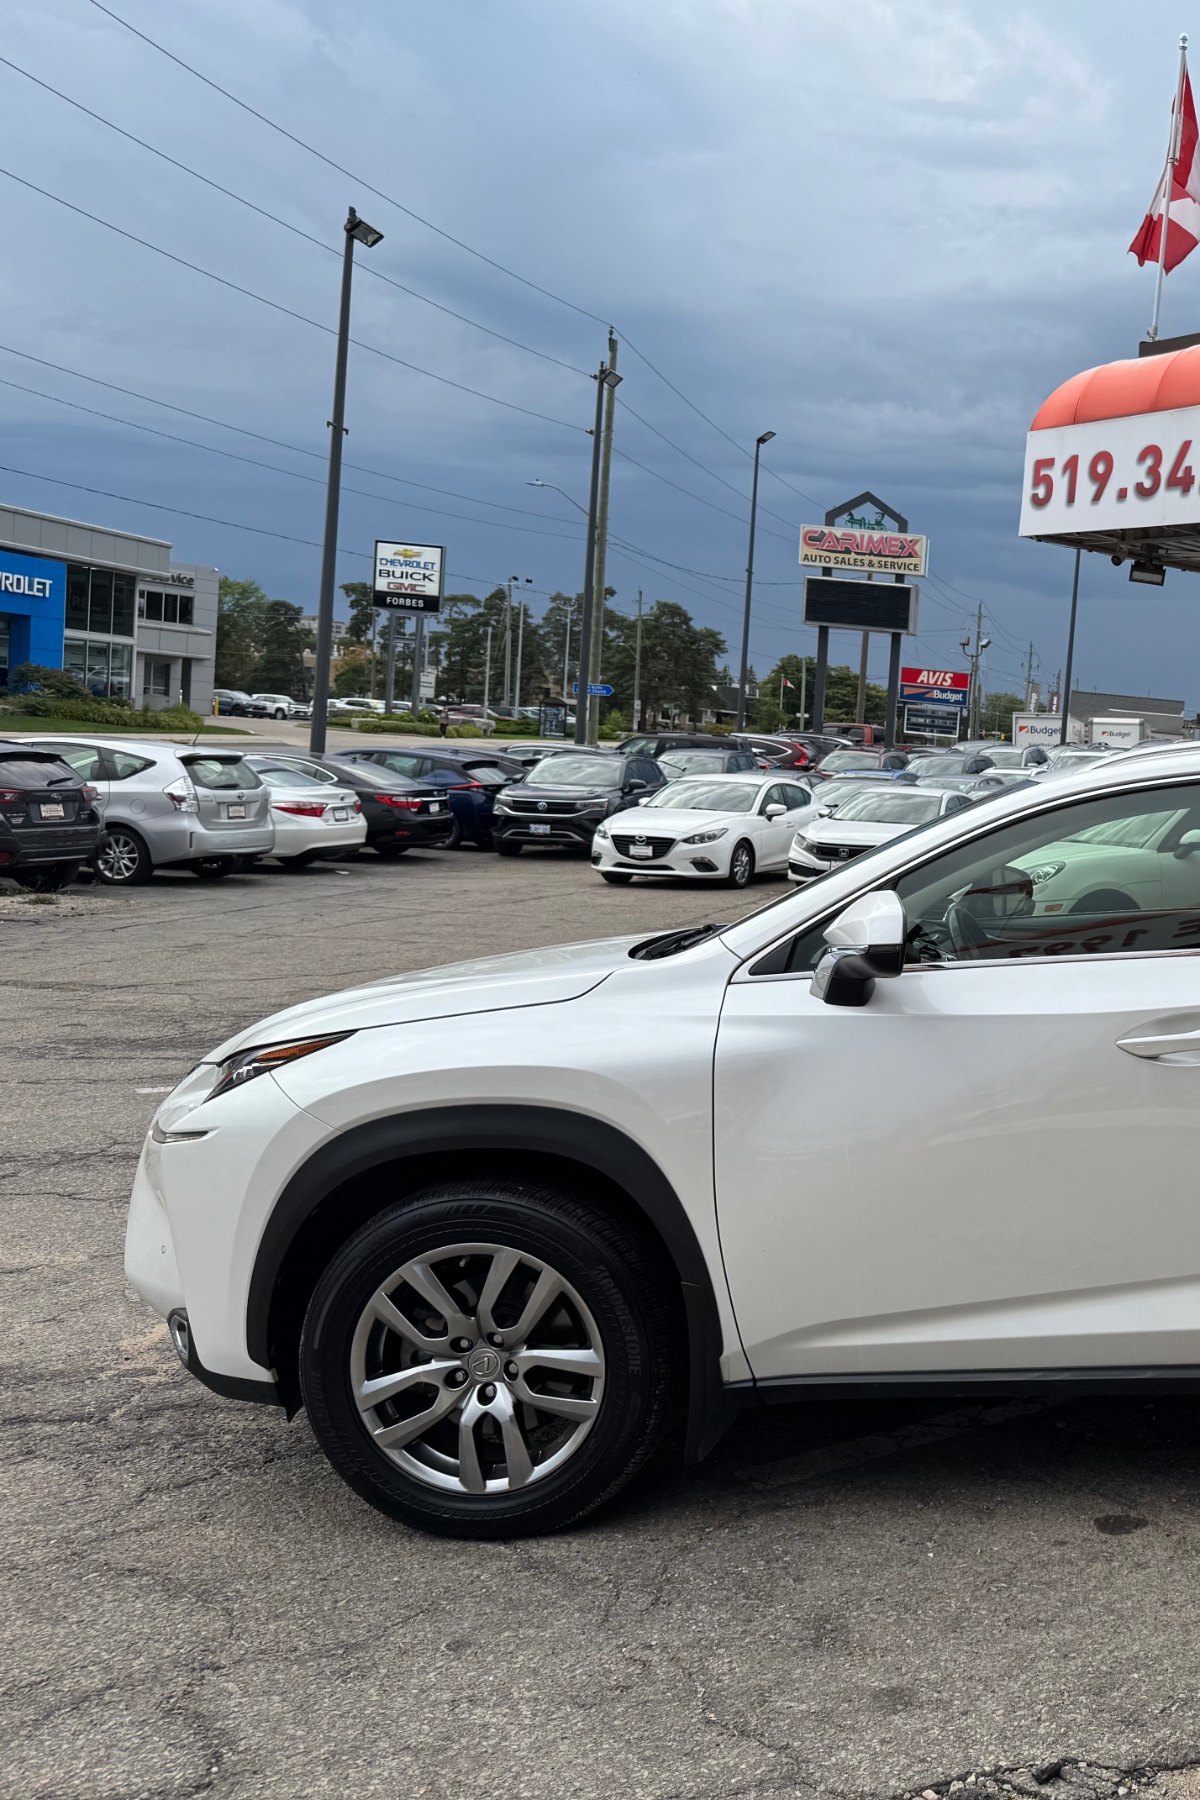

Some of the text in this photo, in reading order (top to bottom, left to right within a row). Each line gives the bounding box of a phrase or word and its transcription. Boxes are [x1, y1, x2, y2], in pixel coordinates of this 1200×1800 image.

[803, 529, 922, 557] CARIMEX
[380, 557, 436, 570] CHEVROLET
[803, 553, 920, 572] AUTO SALES & SERVICE
[378, 569, 435, 582] BUICK
[0, 571, 53, 598] ROLET
[387, 581, 426, 593] GMC
[386, 597, 424, 608] FORBES
[917, 670, 954, 687] AVIS
[933, 689, 963, 702] Budget
[1030, 725, 1062, 736] Budget
[1109, 731, 1131, 739] Budget
[590, 1264, 642, 1376] BRIDGESTONE
